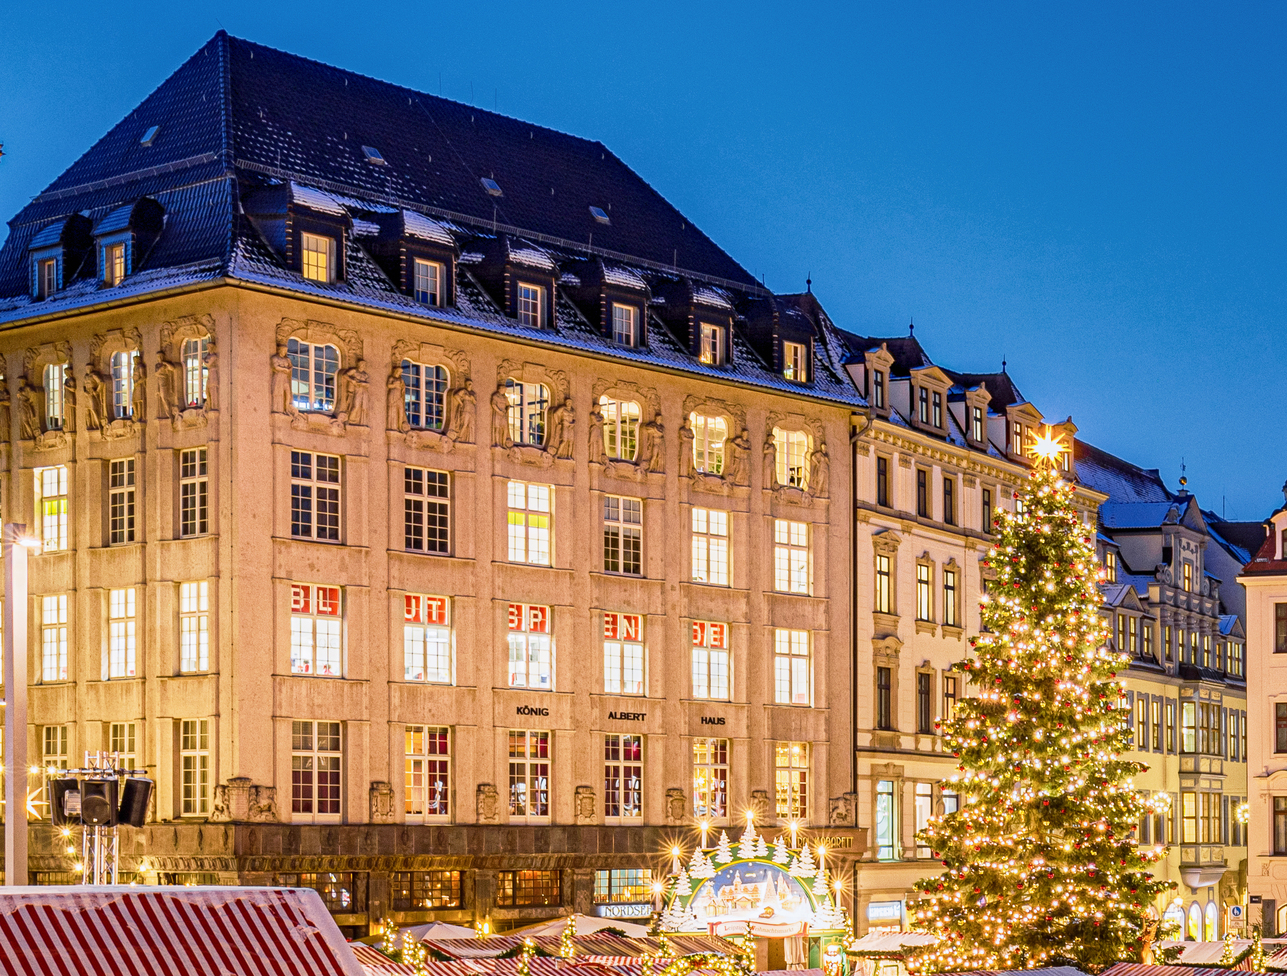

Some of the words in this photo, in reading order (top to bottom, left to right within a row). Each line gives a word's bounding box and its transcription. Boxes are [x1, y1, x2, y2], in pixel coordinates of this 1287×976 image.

[516, 704, 549, 717] KÖNIG
[608, 711, 647, 722] ALBERT
[700, 716, 726, 726] HAUS
